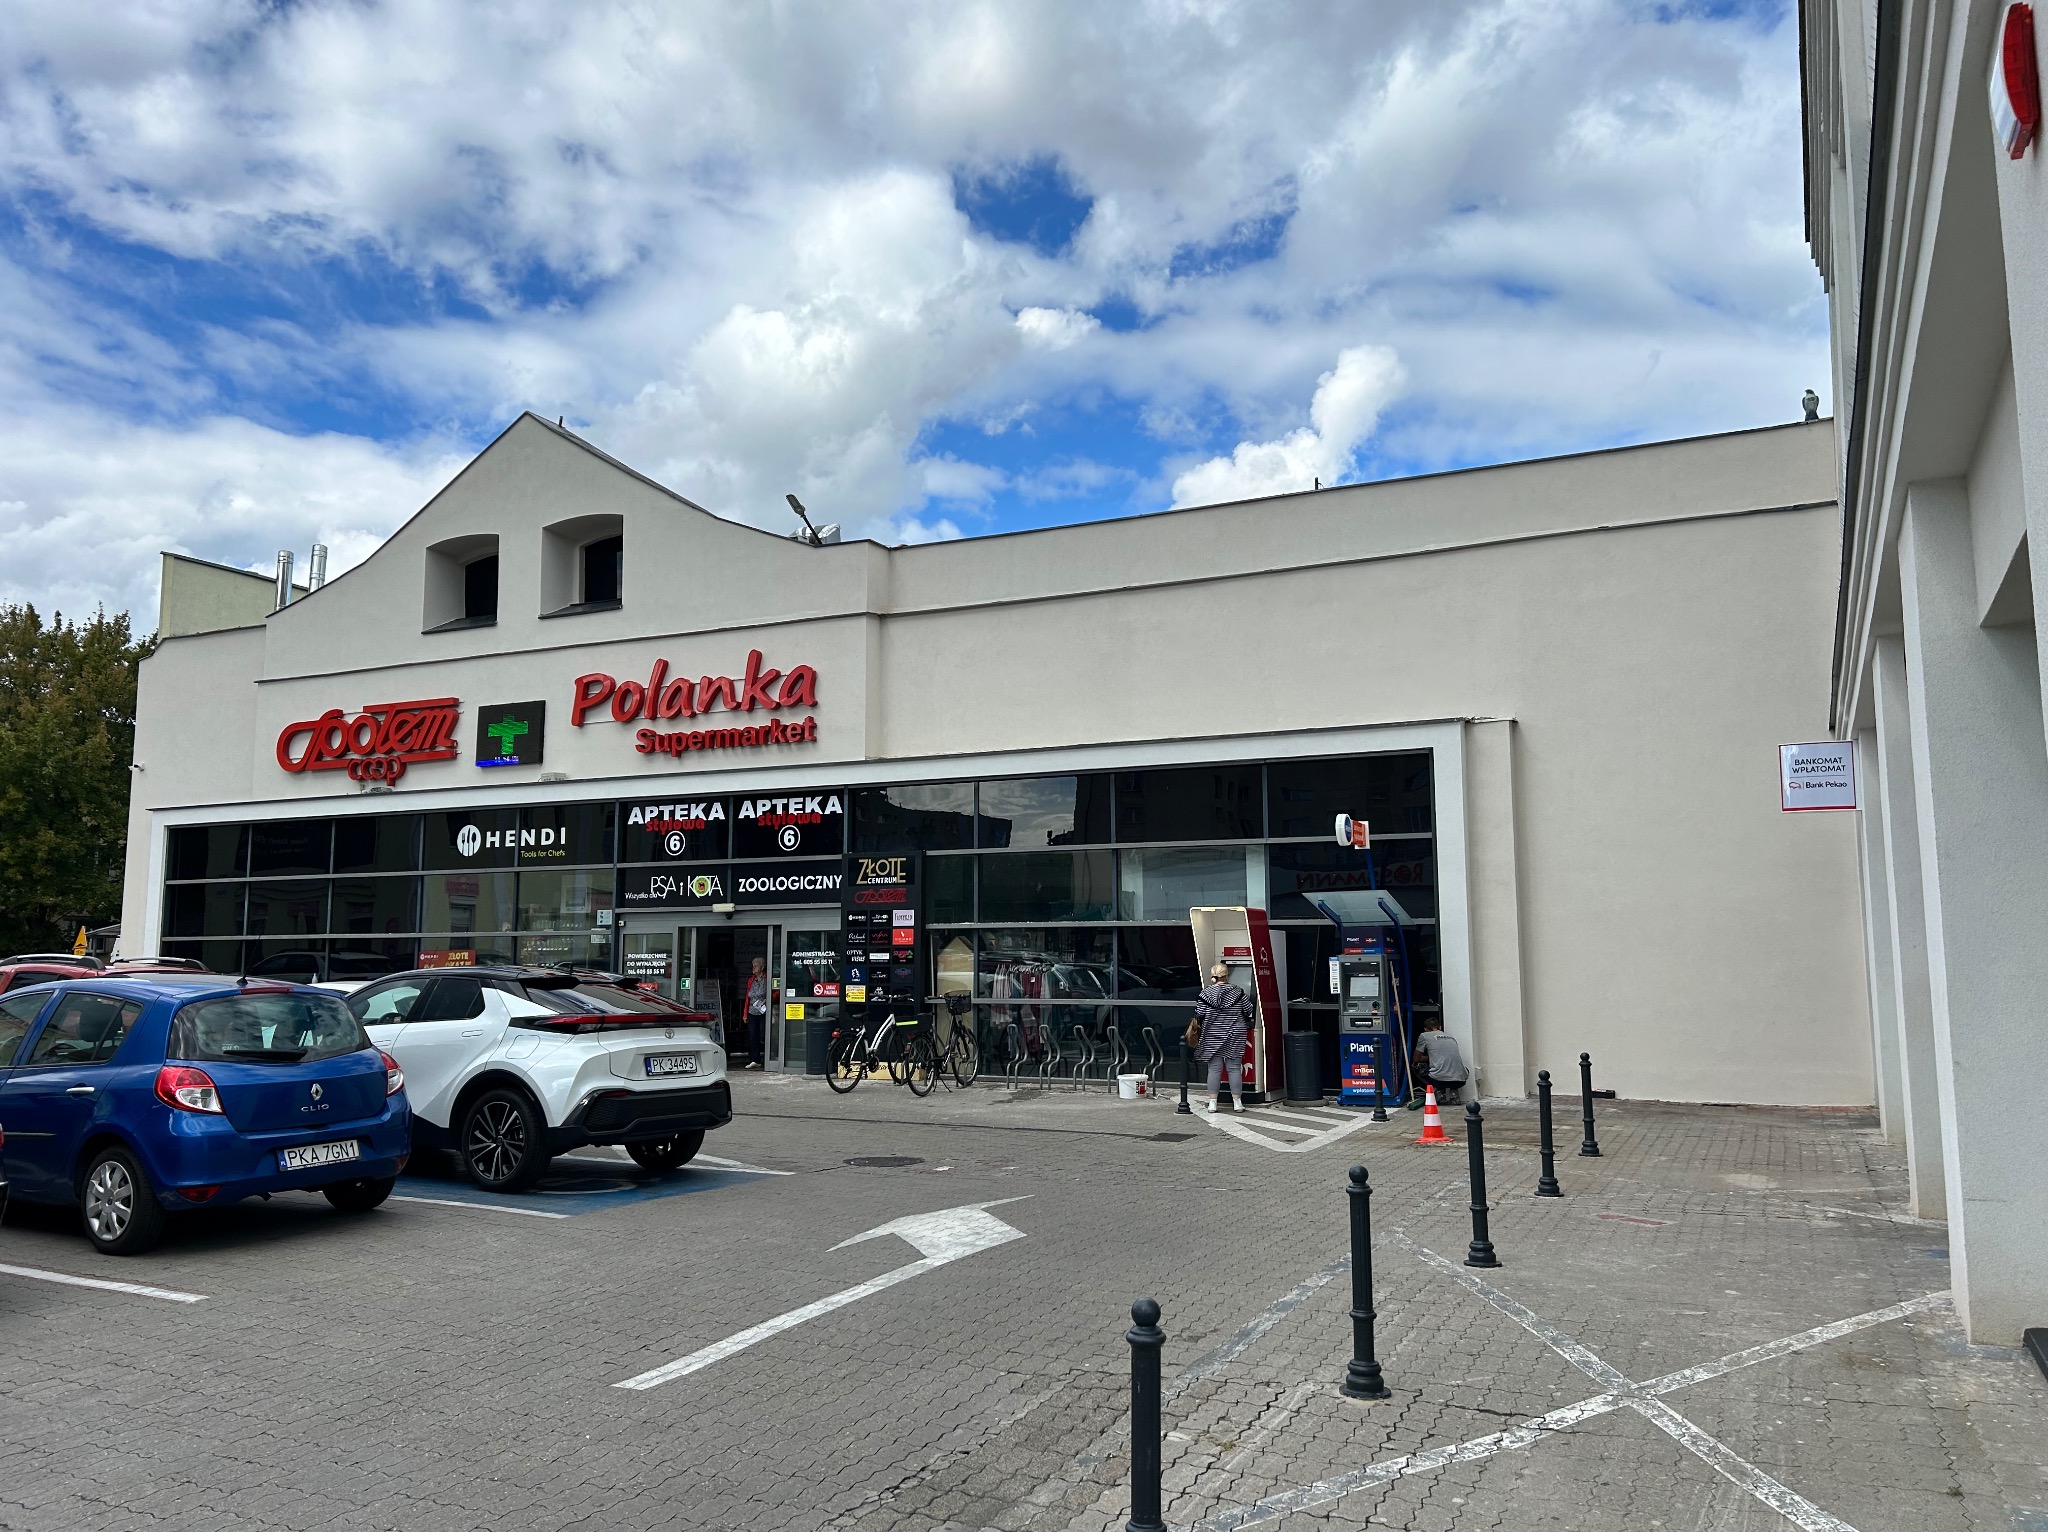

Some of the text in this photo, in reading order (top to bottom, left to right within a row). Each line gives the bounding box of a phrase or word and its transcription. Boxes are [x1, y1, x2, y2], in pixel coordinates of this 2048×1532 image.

[571, 649, 818, 727] Polanka
[635, 716, 818, 758] Supermarket
[1792, 765, 1846, 774] WPŁATOMAT
[1794, 757, 1842, 766] BANKOMAT
[628, 802, 725, 825] APTEKA
[738, 795, 843, 819] APTEKA
[646, 817, 706, 835] stylowa
[758, 811, 821, 830] stylowa
[486, 827, 566, 848] HENDI
[670, 836, 681, 852] 6
[784, 830, 795, 846] 6
[856, 858, 906, 884] ZŁOTE
[650, 876, 676, 899] PSA
[738, 875, 842, 892] ZOOLOGICZNY
[1350, 1043, 1374, 1052] Plane
[653, 1057, 694, 1071] PK 3449S
[287, 1148, 320, 1166] PKA
[322, 1142, 356, 1160] 7GN1
